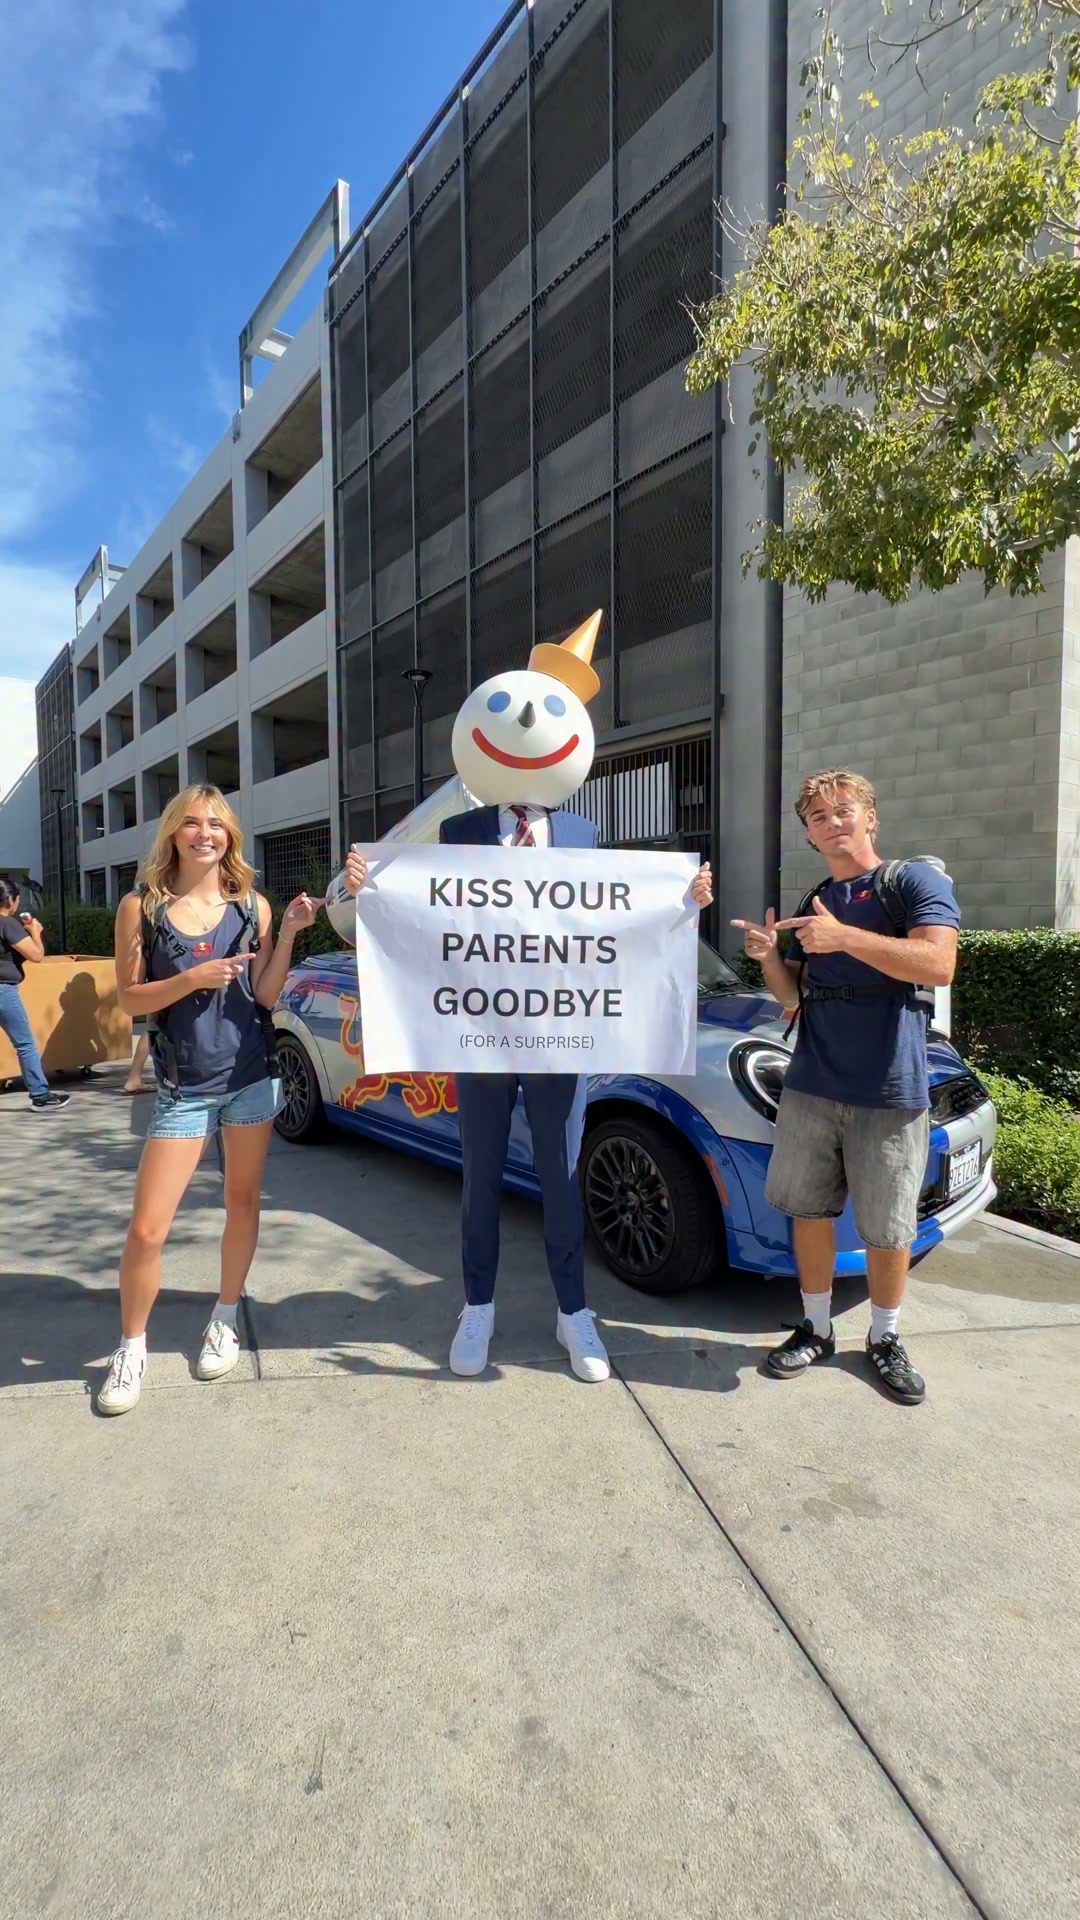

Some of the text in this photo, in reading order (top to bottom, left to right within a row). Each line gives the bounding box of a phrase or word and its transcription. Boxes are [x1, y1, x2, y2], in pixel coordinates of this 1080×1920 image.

[429, 877, 632, 910] KISS YOUR
[442, 933, 617, 964] PARENTS
[433, 986, 622, 1017] GOODBYE
[459, 1034, 595, 1049] (FOR A SURPRISE)
